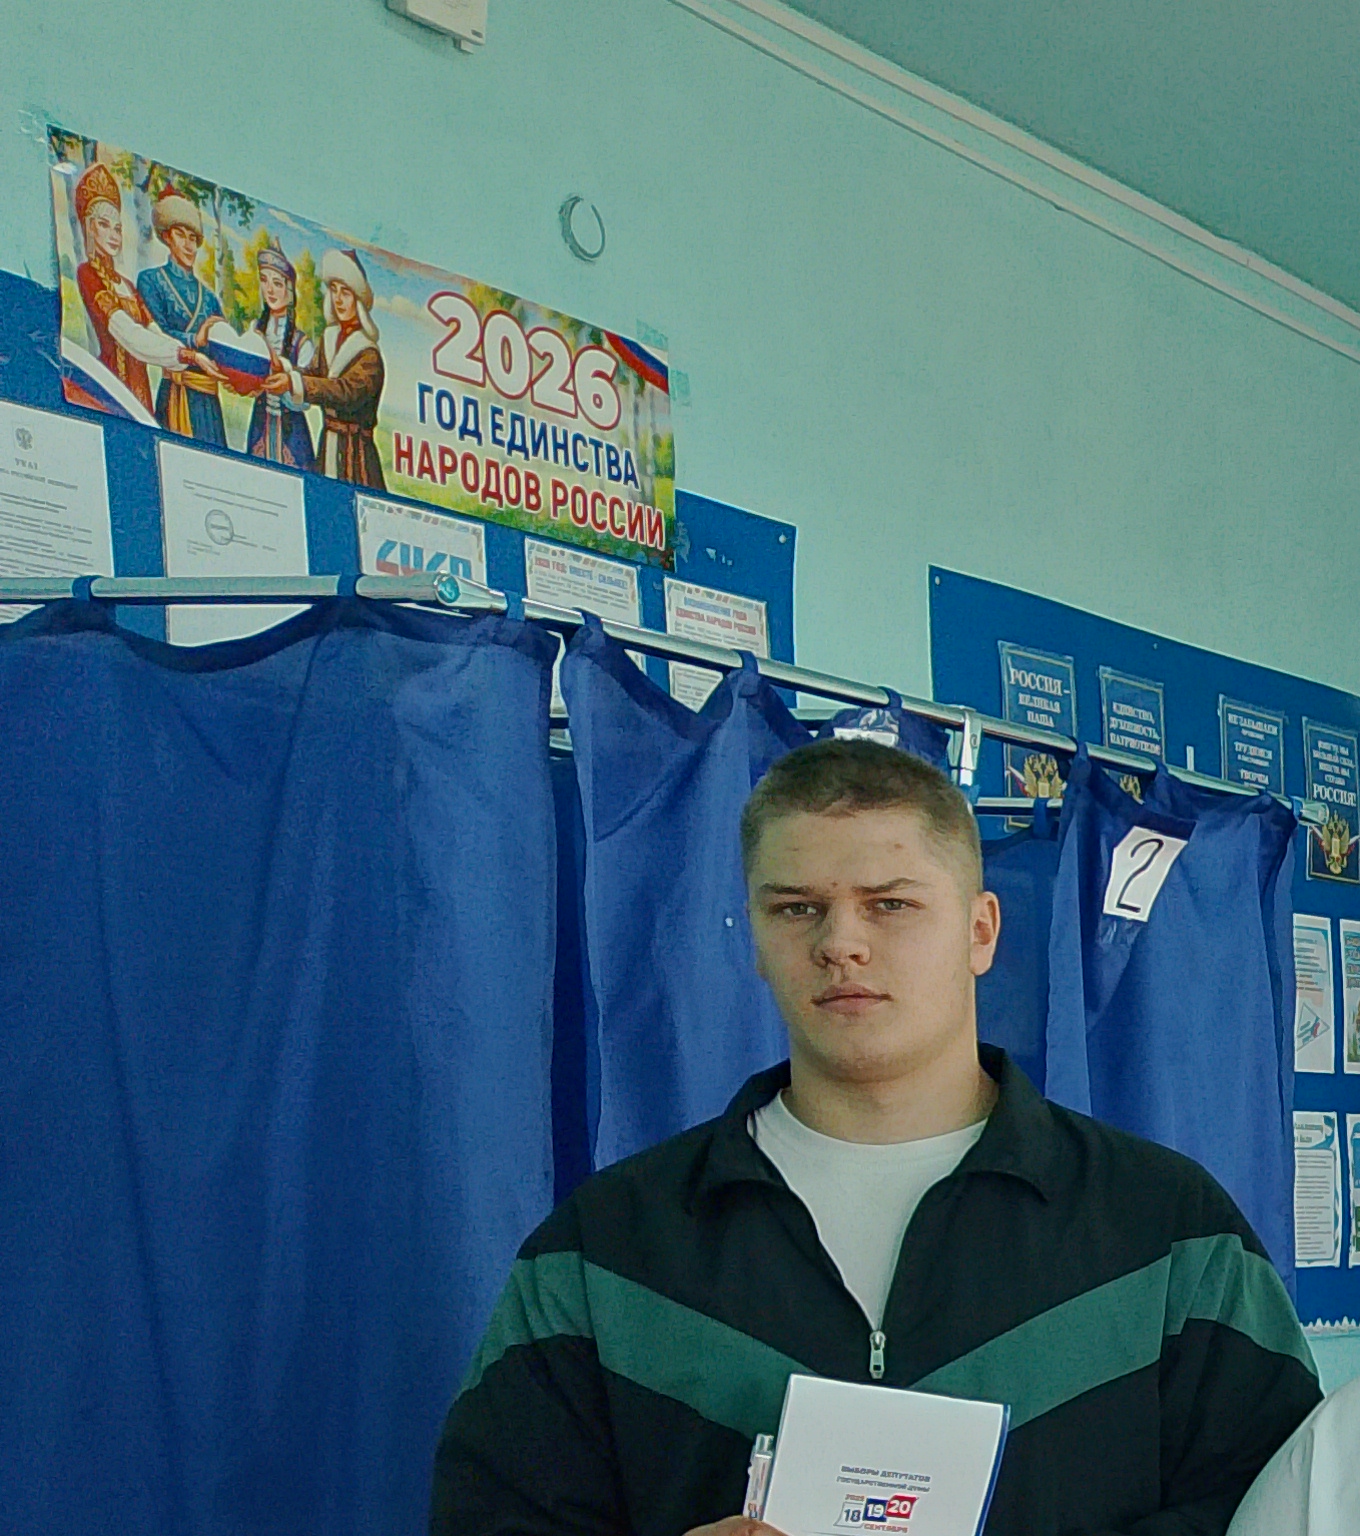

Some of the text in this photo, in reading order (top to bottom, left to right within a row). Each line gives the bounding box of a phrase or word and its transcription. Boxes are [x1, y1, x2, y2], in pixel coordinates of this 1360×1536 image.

[427, 291, 622, 431] 2026
[417, 382, 640, 490] ГОД ЕДИНСТВА
[393, 432, 666, 550] НАРОДОВ РОССИИ
[1009, 667, 1063, 697] РОССИЯ
[1116, 838, 1164, 914] 2
[843, 1500, 912, 1523] 18 19 20
